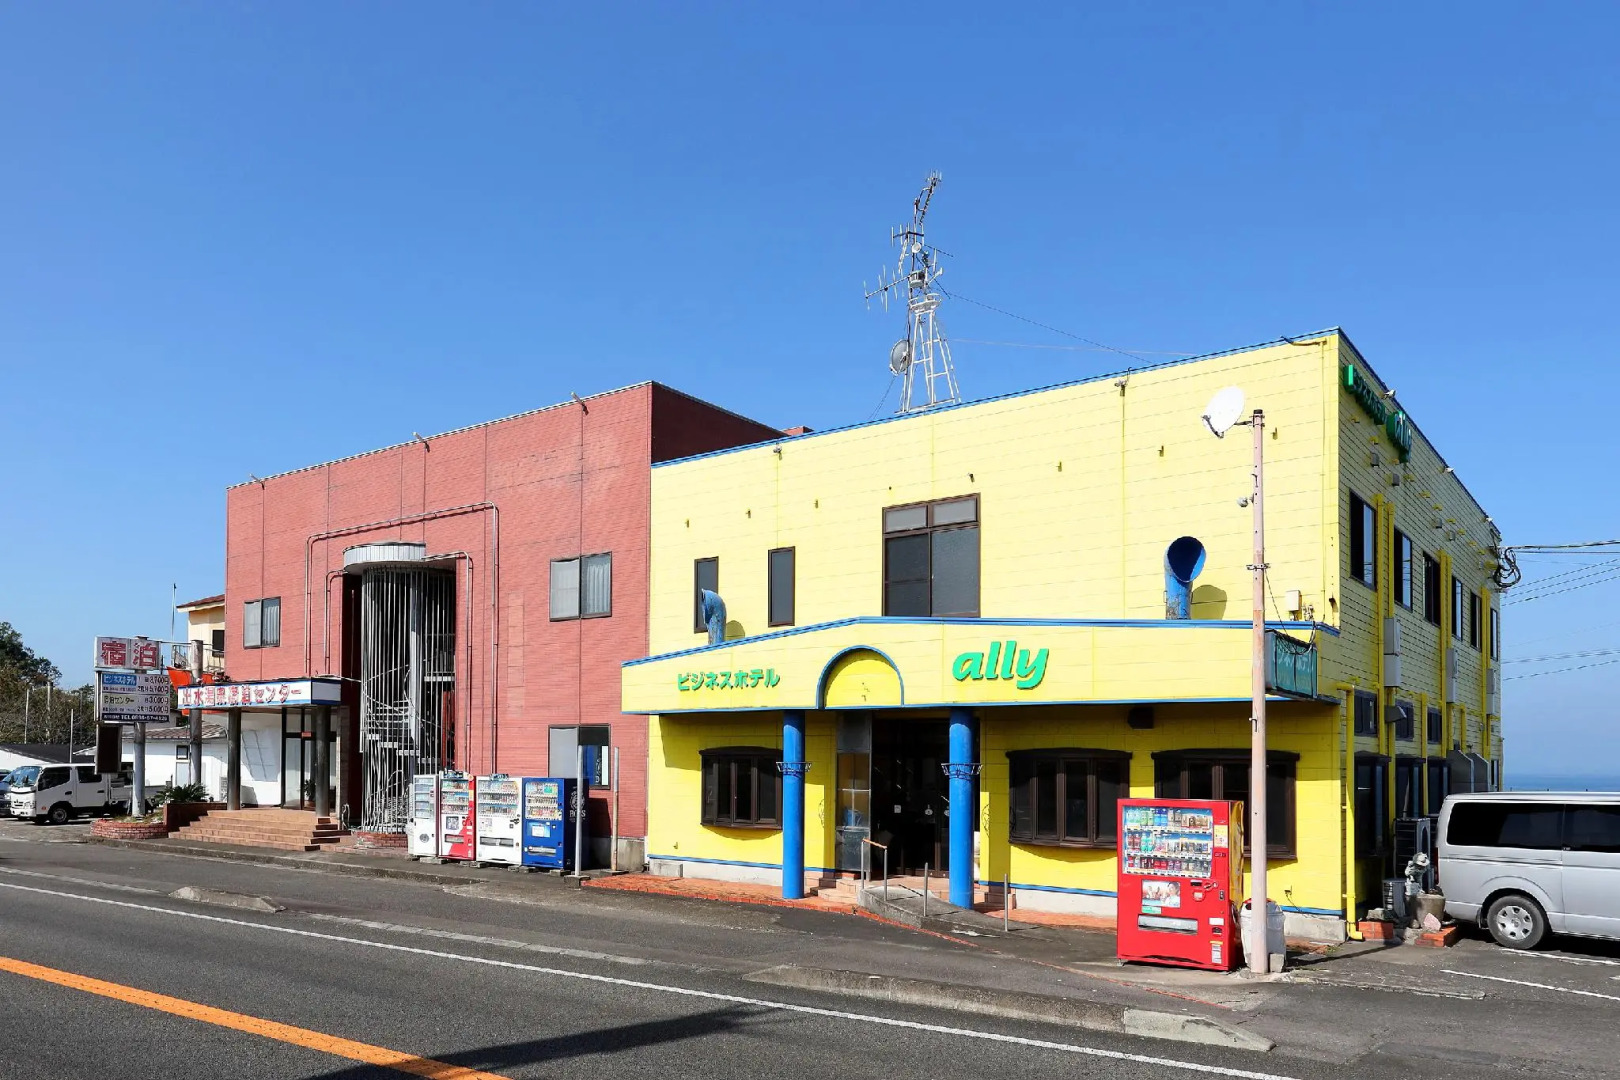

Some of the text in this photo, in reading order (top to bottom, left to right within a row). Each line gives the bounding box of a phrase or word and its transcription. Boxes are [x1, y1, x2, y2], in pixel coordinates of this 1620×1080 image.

[101, 640, 158, 668] 宿泊
[952, 640, 1049, 690] ally
[677, 668, 780, 692] ビジネスホテル
[569, 809, 586, 818] BOS
